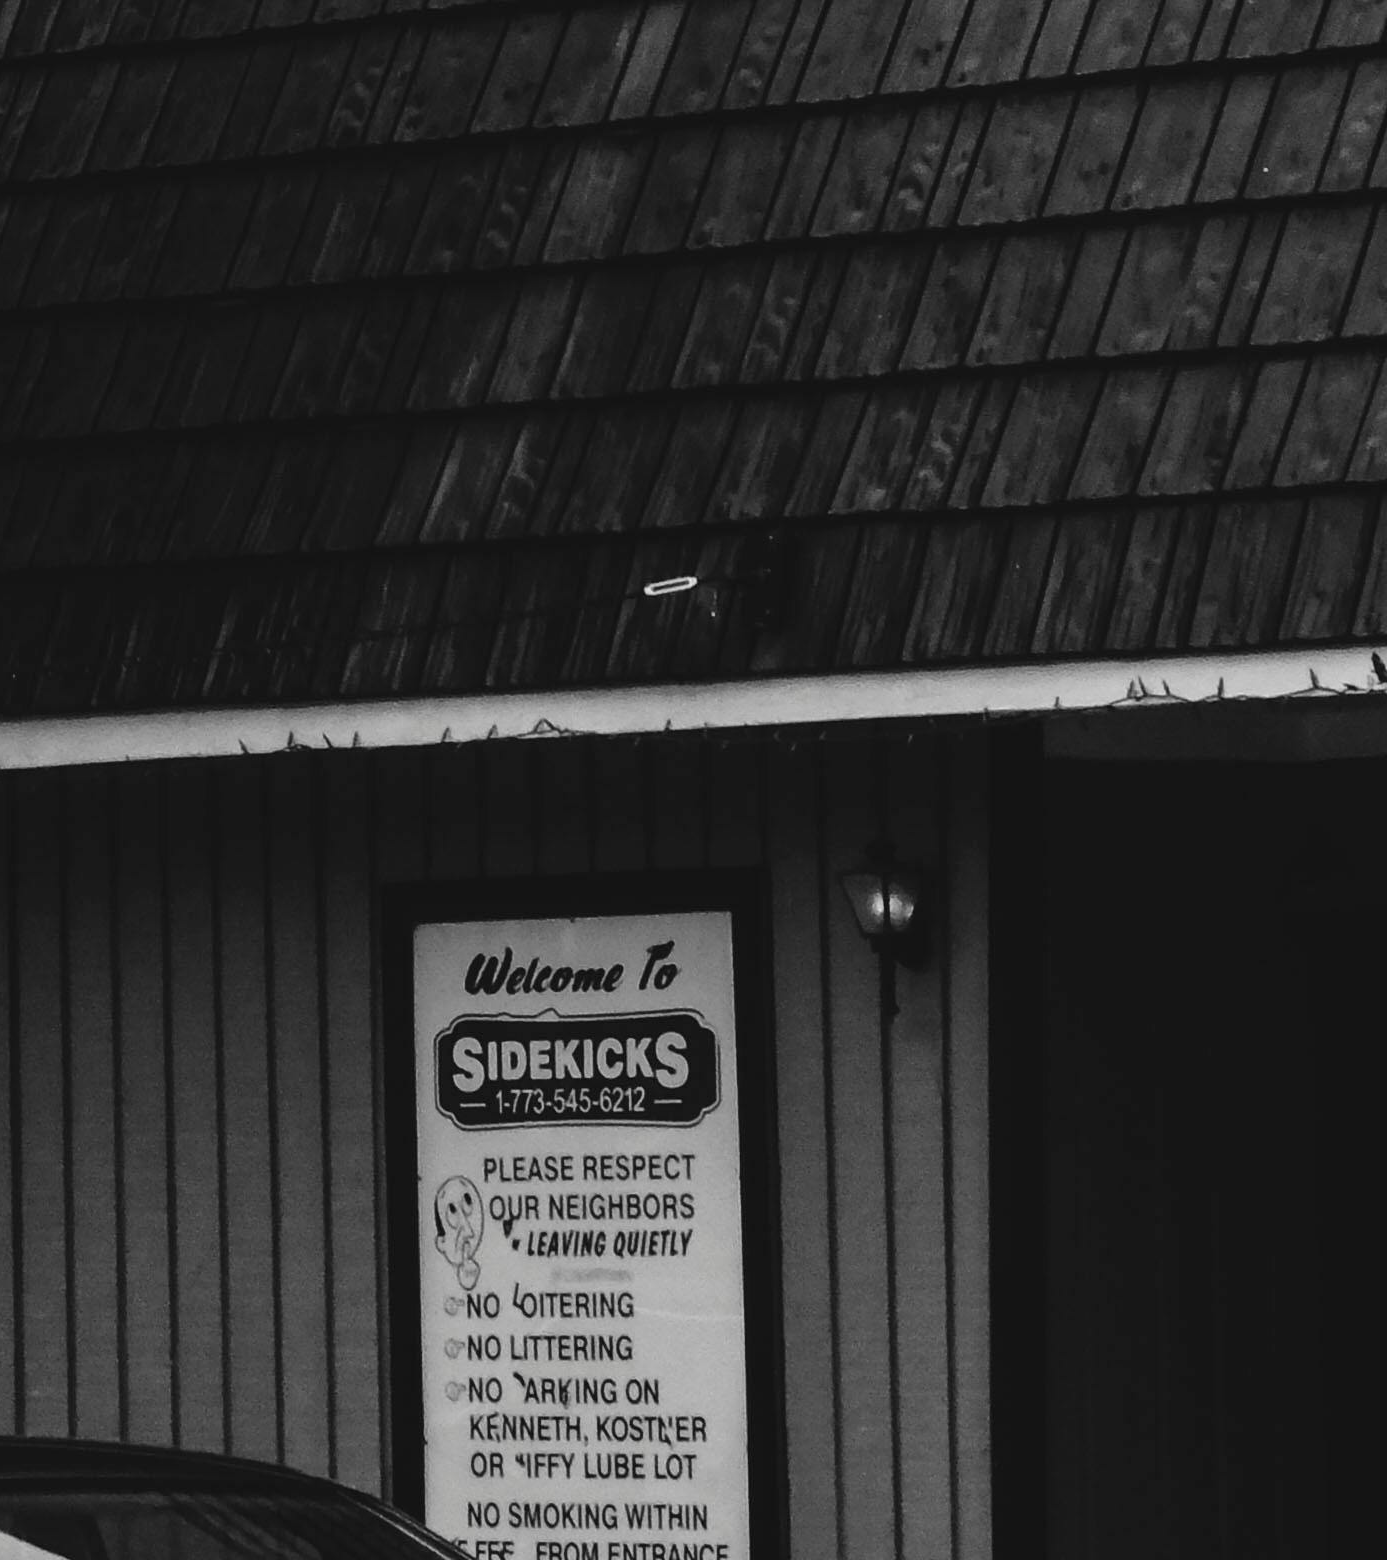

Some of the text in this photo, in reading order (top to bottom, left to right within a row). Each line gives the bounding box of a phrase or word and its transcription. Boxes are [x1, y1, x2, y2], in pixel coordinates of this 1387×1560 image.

[464, 940, 680, 995] Welcome To
[452, 1031, 689, 1093] SIDEKICKS
[495, 1087, 646, 1115] 1-773-545-6212
[483, 1154, 695, 1182] PLEASE RESPECT
[489, 1193, 695, 1221] OUR NEIGHBORS
[527, 1229, 605, 1258] LEAVING
[613, 1228, 693, 1257] QUIETLY
[466, 1292, 500, 1319] NO
[467, 1335, 633, 1361] NO LITTERING
[468, 1377, 502, 1403] NO
[625, 1378, 660, 1405] ON
[470, 1452, 504, 1478] OR
[584, 1453, 646, 1480] LUBE
[654, 1454, 697, 1480] LOT
[467, 1501, 709, 1530] NO SMOKING WITHIN
